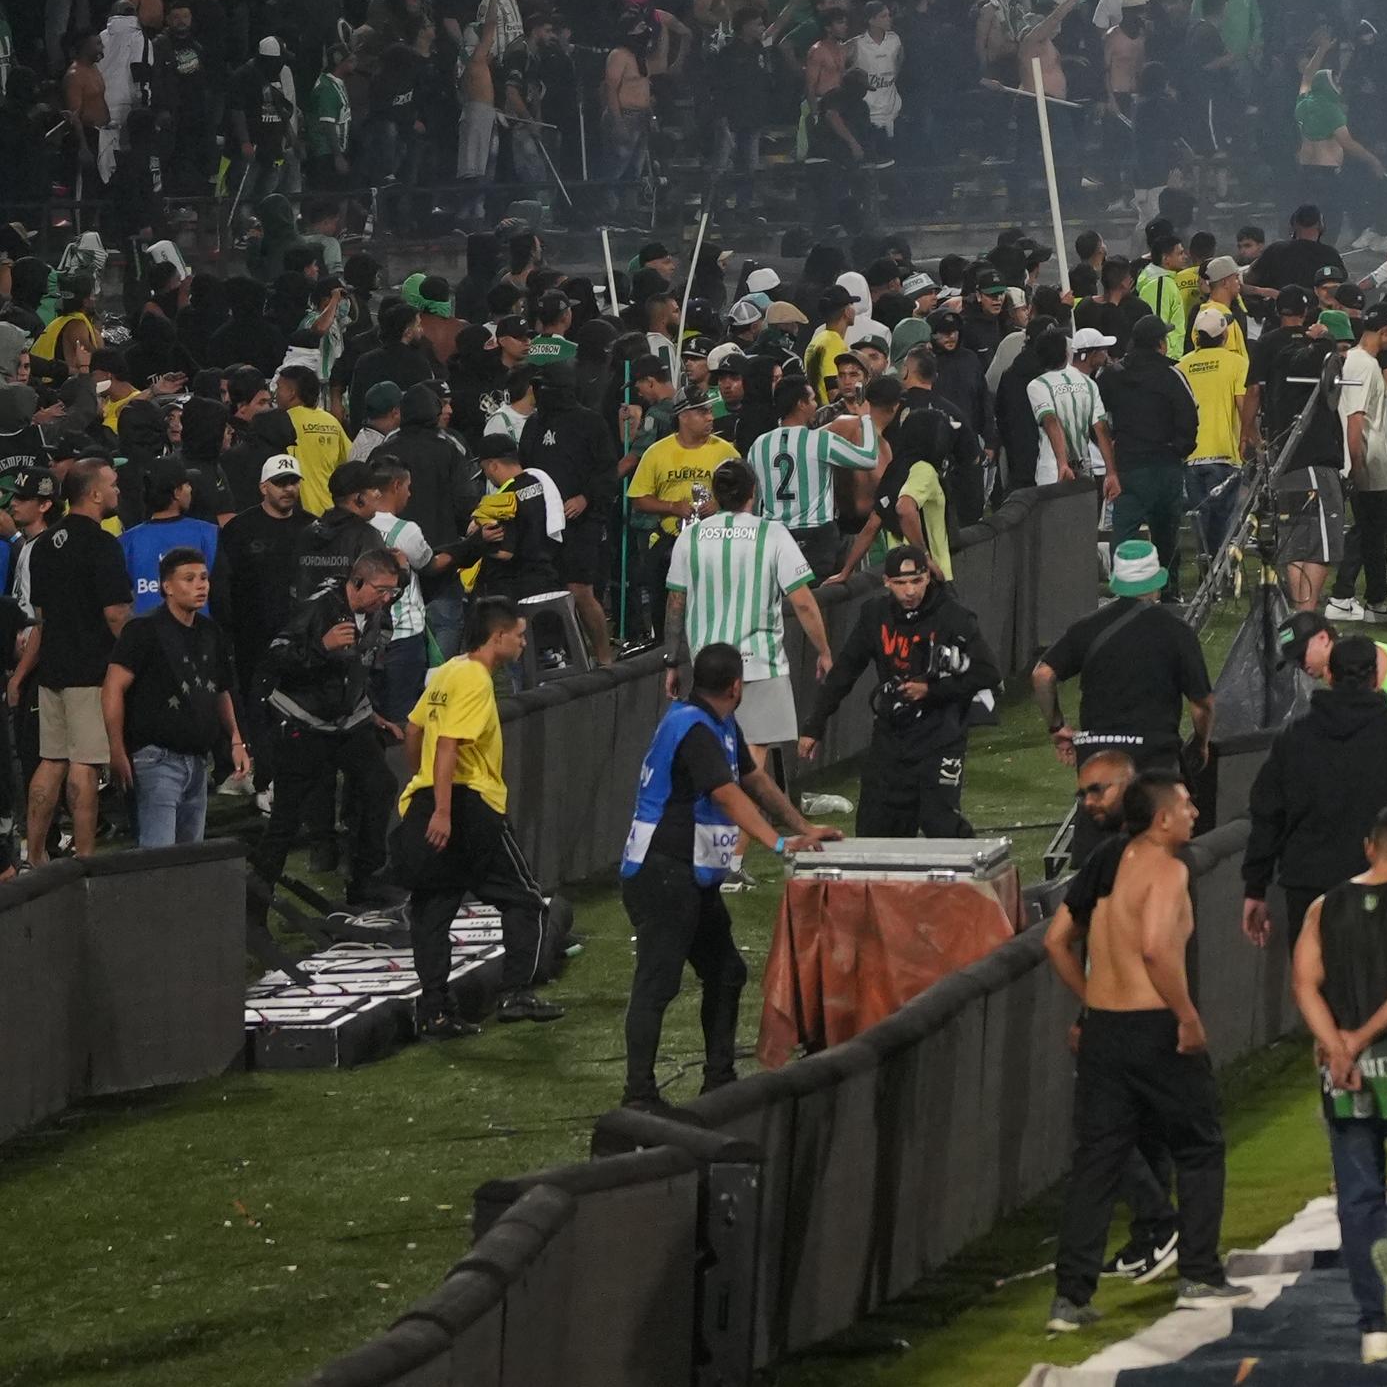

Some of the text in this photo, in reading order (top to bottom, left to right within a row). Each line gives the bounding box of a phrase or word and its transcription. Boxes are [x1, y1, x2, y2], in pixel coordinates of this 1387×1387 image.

[530, 343, 561, 357] OSTOBON
[667, 469, 711, 481] FUERZA
[768, 453, 794, 501] 2
[698, 526, 757, 541] POSTOBON
[137, 578, 158, 595] Be
